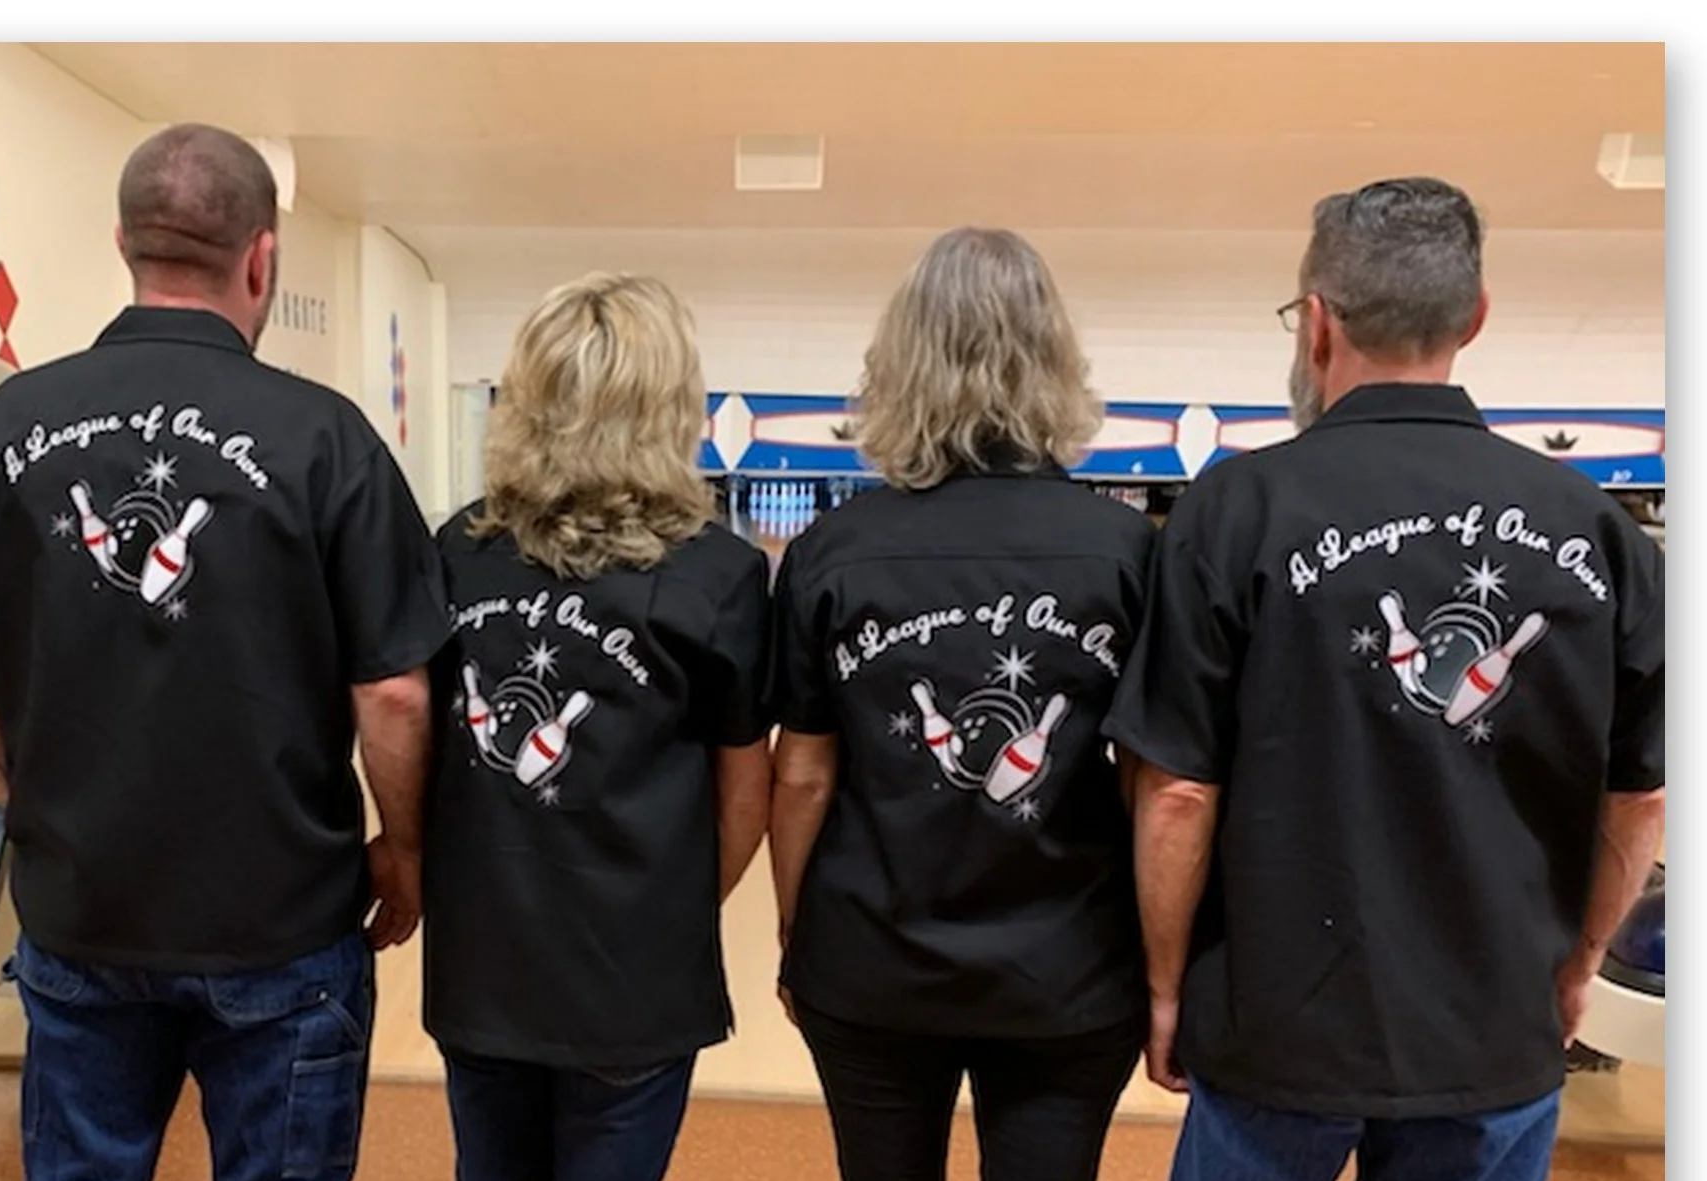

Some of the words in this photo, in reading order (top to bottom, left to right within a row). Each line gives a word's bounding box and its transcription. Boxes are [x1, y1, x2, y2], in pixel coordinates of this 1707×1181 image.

[3, 445, 25, 484] A
[25, 423, 123, 463] League
[129, 403, 165, 442] of
[171, 406, 217, 445] Our
[219, 434, 269, 490] Own
[1287, 549, 1319, 596] A
[1316, 526, 1436, 571] League
[1444, 503, 1486, 547] of
[1495, 506, 1553, 553] Our
[1554, 536, 1609, 602] Own
[516, 589, 550, 628] of
[555, 593, 600, 640] Our
[601, 626, 651, 687] Own
[835, 641, 860, 682] A
[857, 618, 967, 662] League
[973, 593, 1016, 637] of
[1024, 593, 1078, 639] Our
